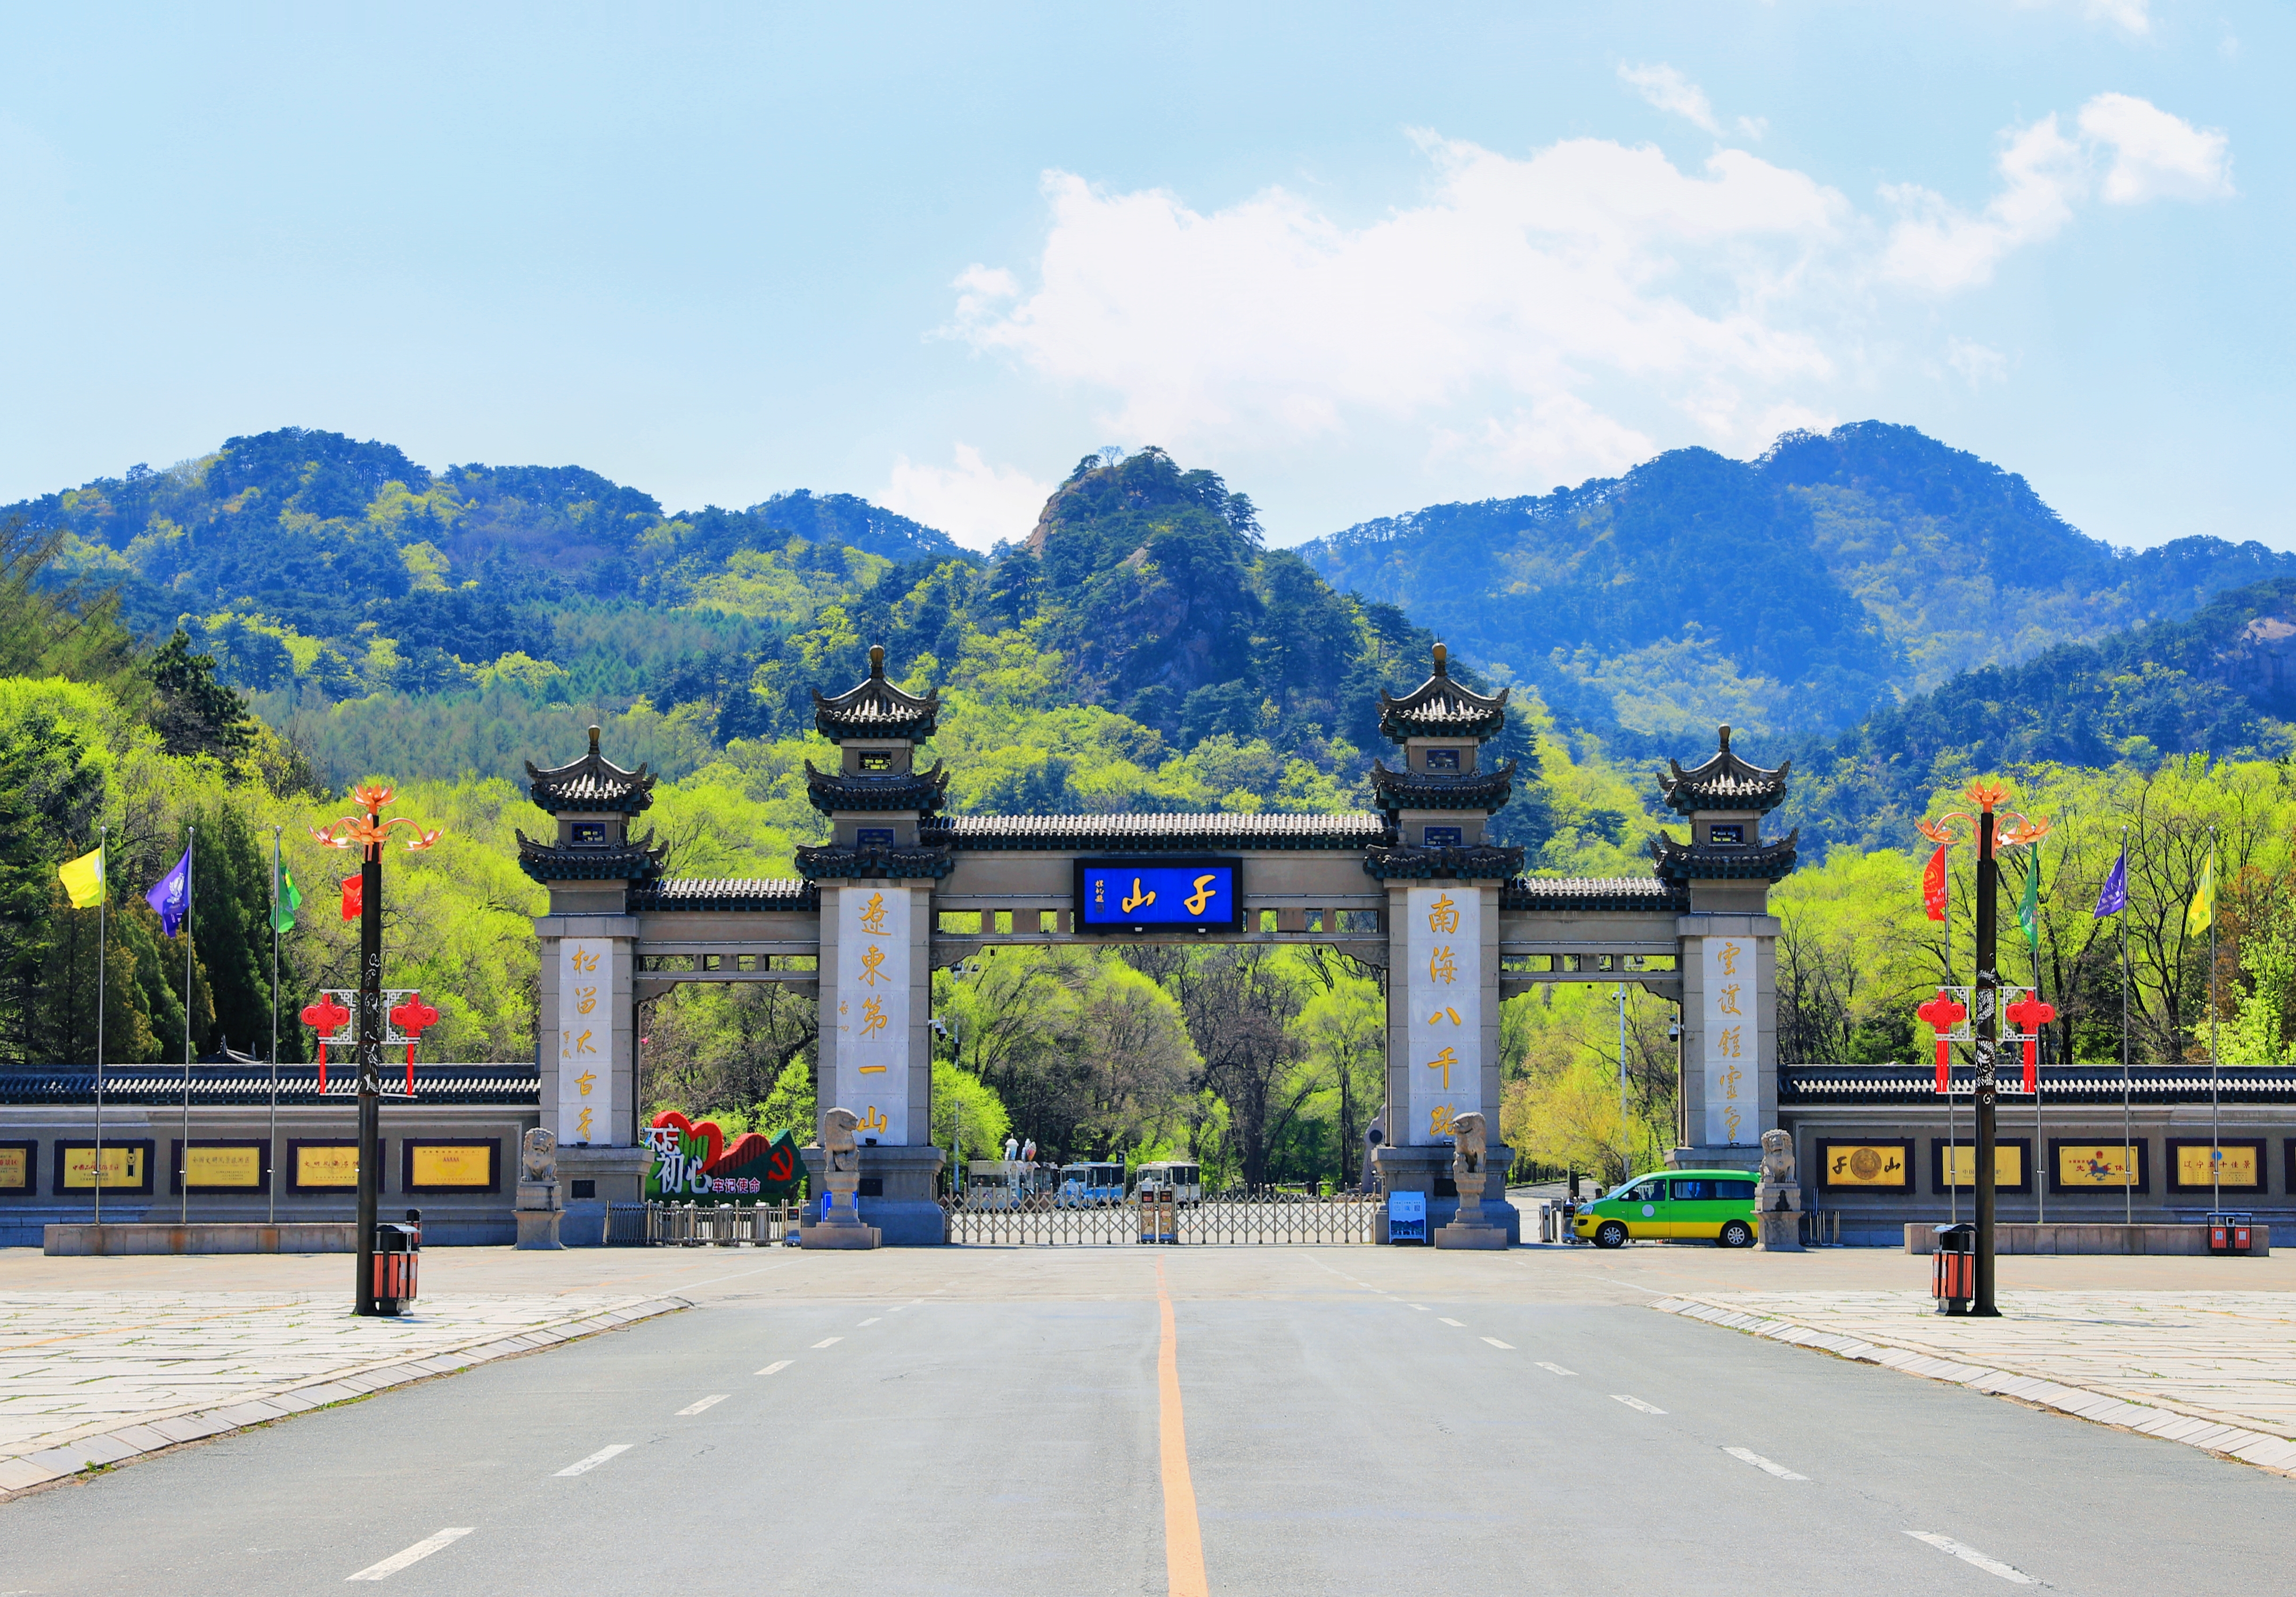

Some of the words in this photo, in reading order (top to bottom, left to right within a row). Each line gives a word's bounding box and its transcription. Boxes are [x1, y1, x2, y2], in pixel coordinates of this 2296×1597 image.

[1428, 893, 1461, 1136] 南海八千路
[642, 1123, 680, 1155] 不忘
[655, 1153, 712, 1194] 初心
[712, 1177, 761, 1194] 牢记使命
